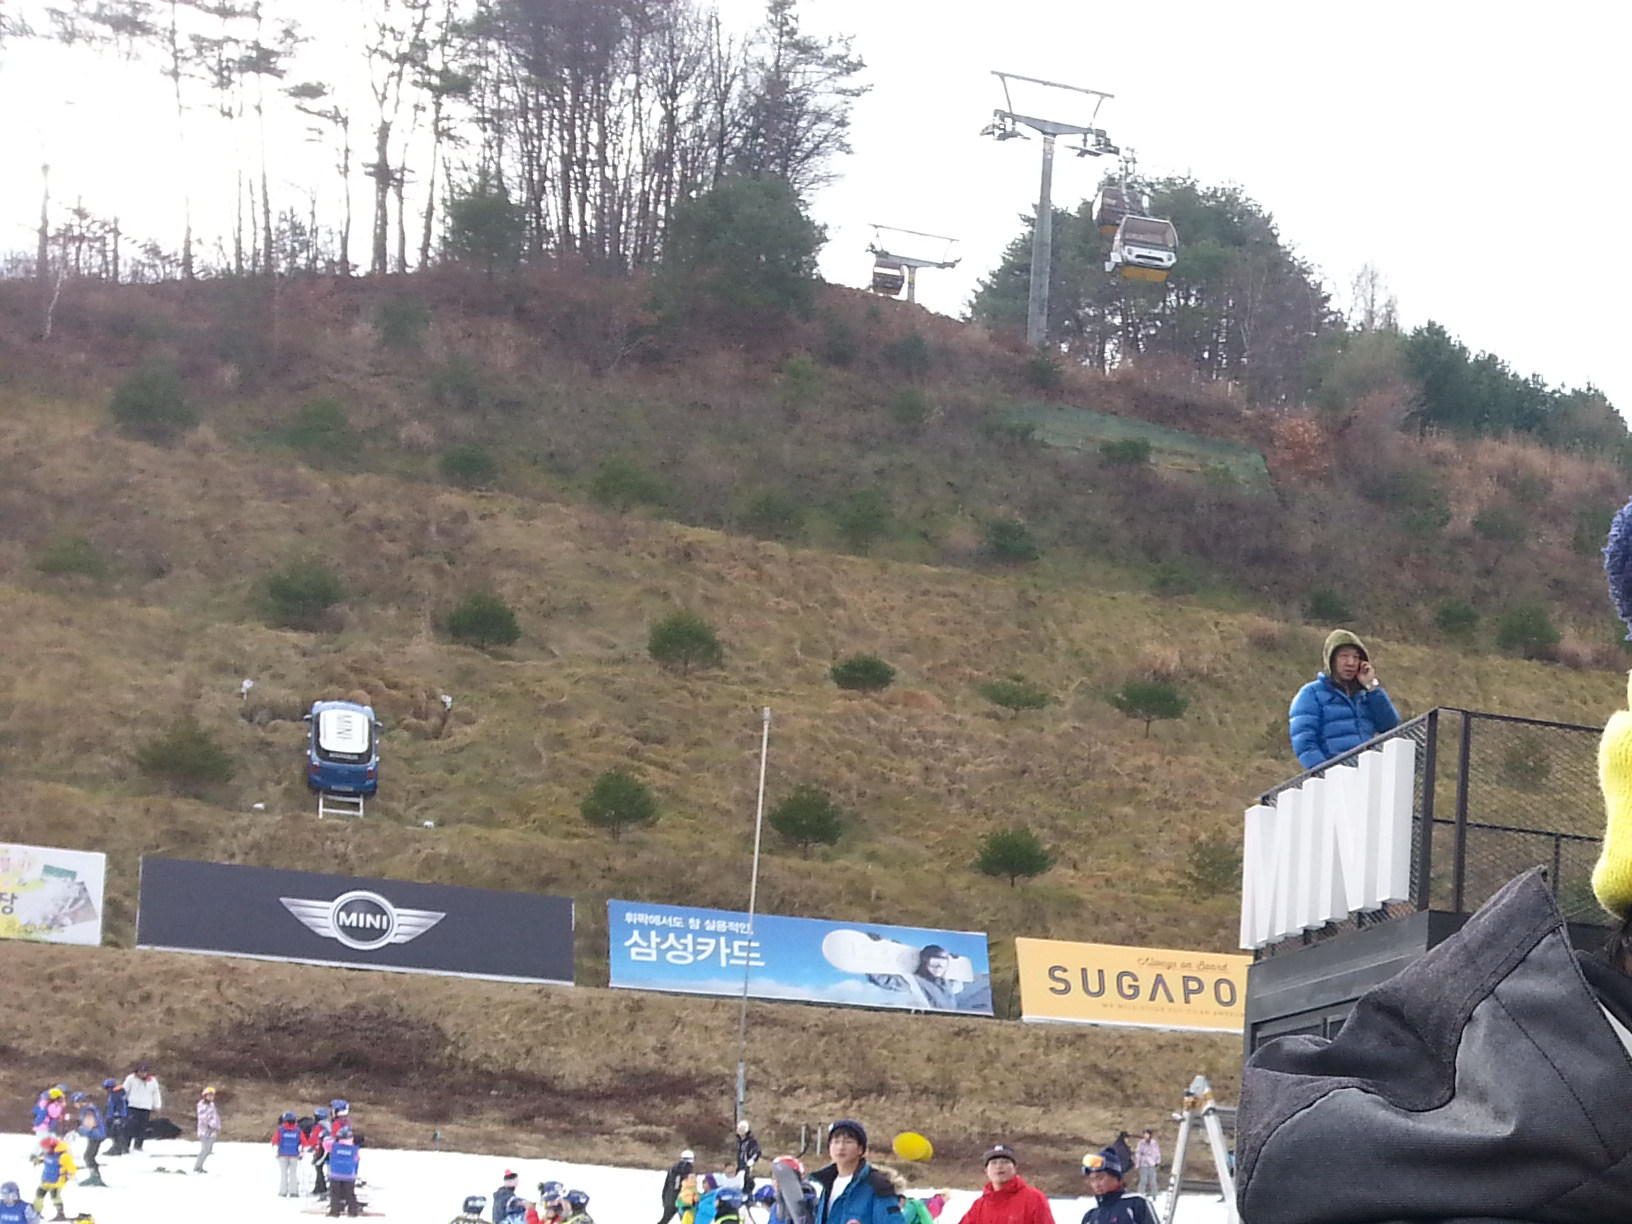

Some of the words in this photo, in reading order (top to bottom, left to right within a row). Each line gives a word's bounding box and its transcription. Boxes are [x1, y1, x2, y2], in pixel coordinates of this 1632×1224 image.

[1240, 737, 1415, 950] MINI
[339, 911, 388, 930] MINI
[624, 930, 766, 967] 삼성카드
[1048, 965, 1237, 1008] SUGAPO
